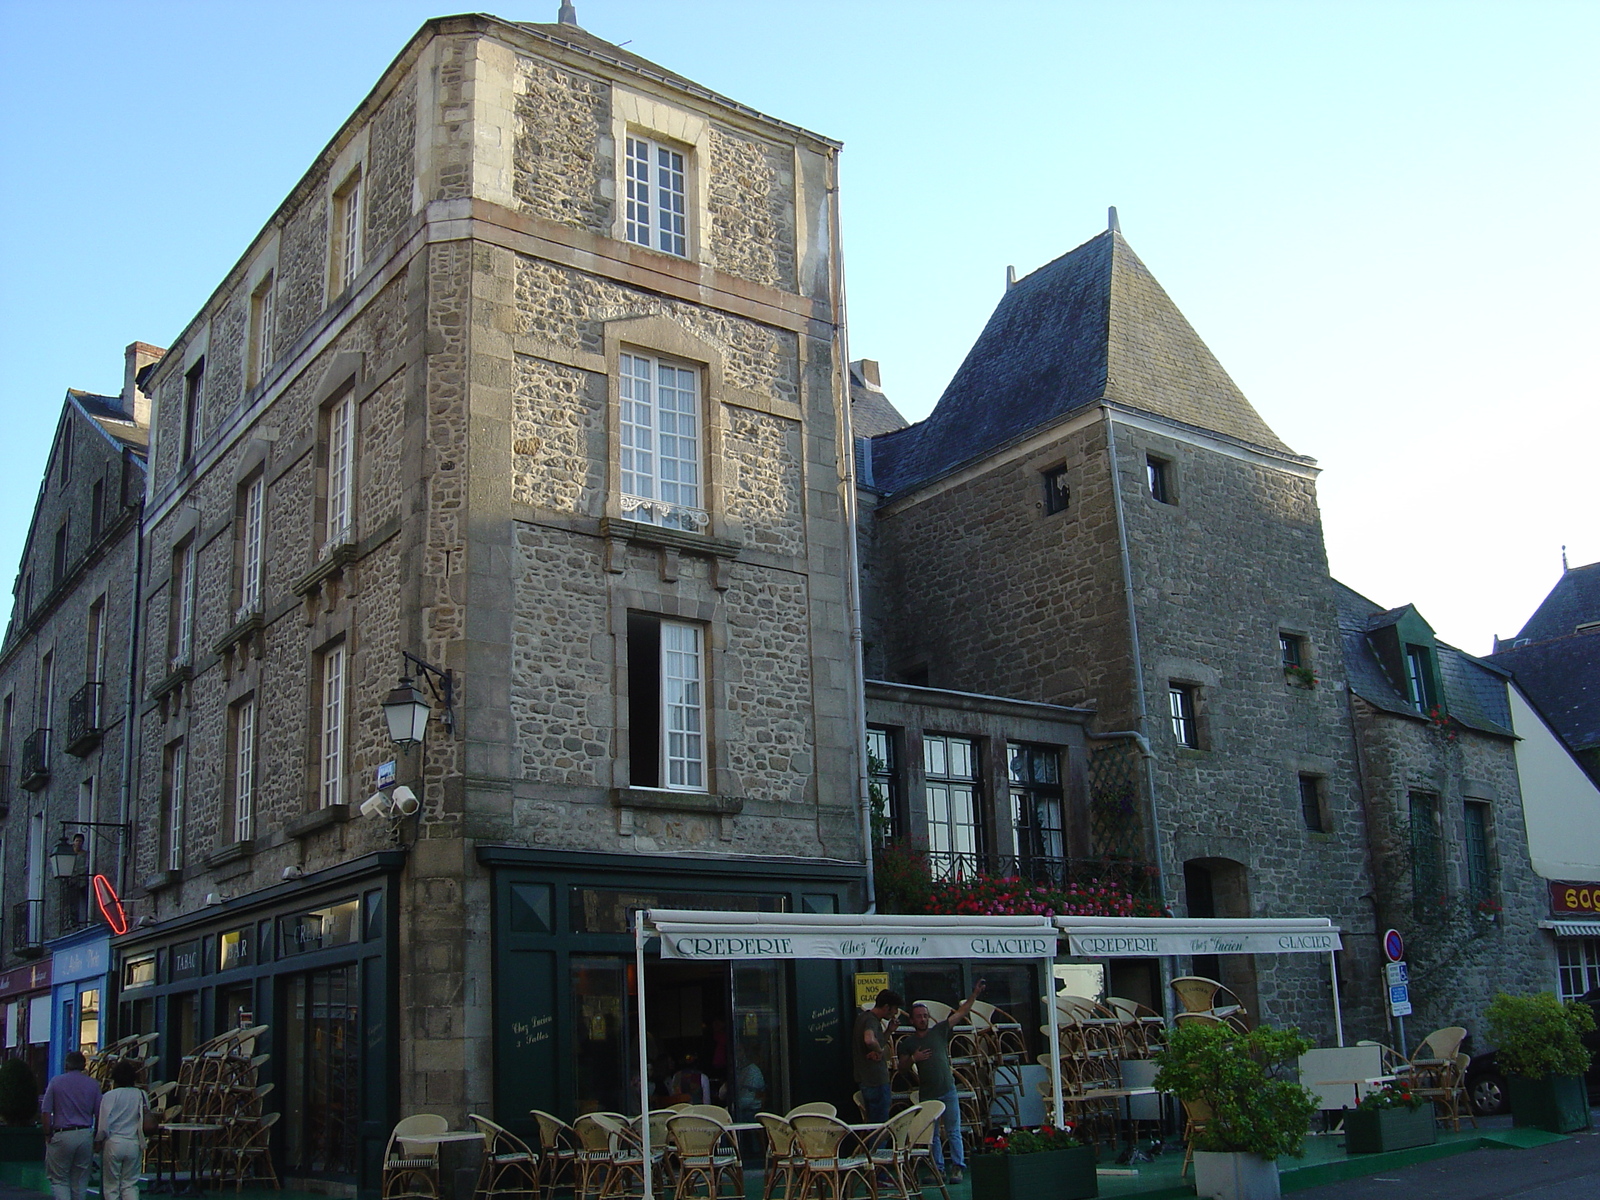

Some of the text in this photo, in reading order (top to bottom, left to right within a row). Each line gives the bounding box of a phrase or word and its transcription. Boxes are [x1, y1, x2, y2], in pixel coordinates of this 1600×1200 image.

[227, 939, 248, 961] BAR
[676, 937, 793, 956] CREPERIE
[839, 940, 866, 956] Chez
[970, 938, 1046, 954] GLACIER
[1081, 937, 1158, 953] CREPERIE
[1190, 939, 1207, 953] Chez
[1278, 935, 1332, 949] GLACIER
[176, 951, 197, 972] TABAC
[511, 1014, 553, 1036] Chez Lucien
[525, 1031, 550, 1045] Salles
